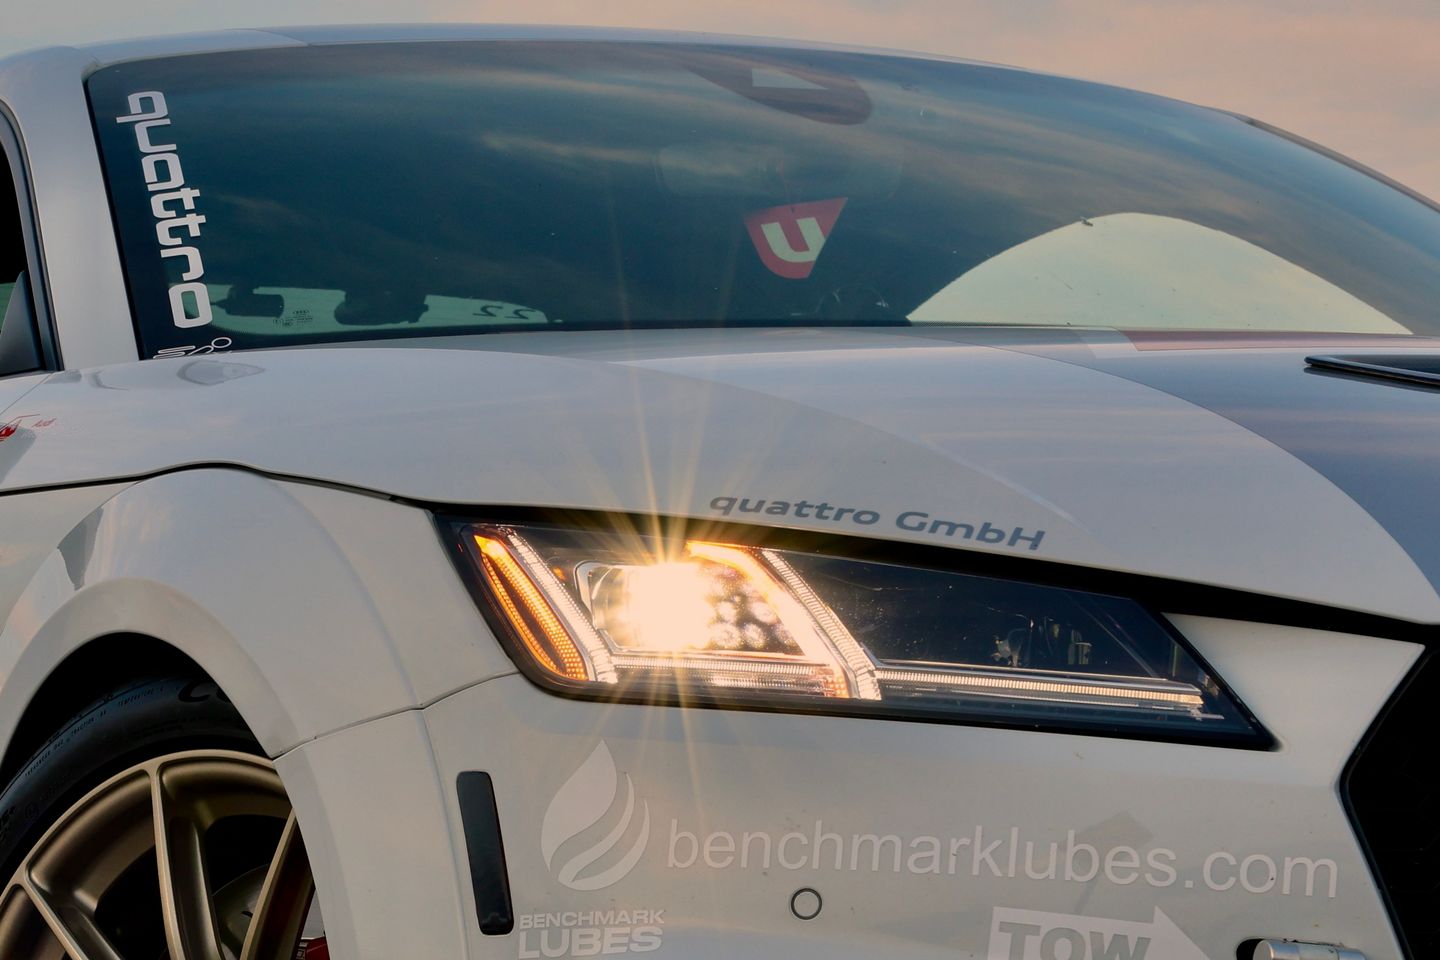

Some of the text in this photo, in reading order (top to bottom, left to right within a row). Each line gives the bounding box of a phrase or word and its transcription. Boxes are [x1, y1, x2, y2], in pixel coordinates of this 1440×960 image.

[116, 90, 213, 329] quattro
[710, 496, 1046, 550] quattro GmbH
[667, 820, 1338, 898] benchmarklubes.com
[519, 910, 665, 929] BENCHMARK
[519, 926, 663, 960] LUBES
